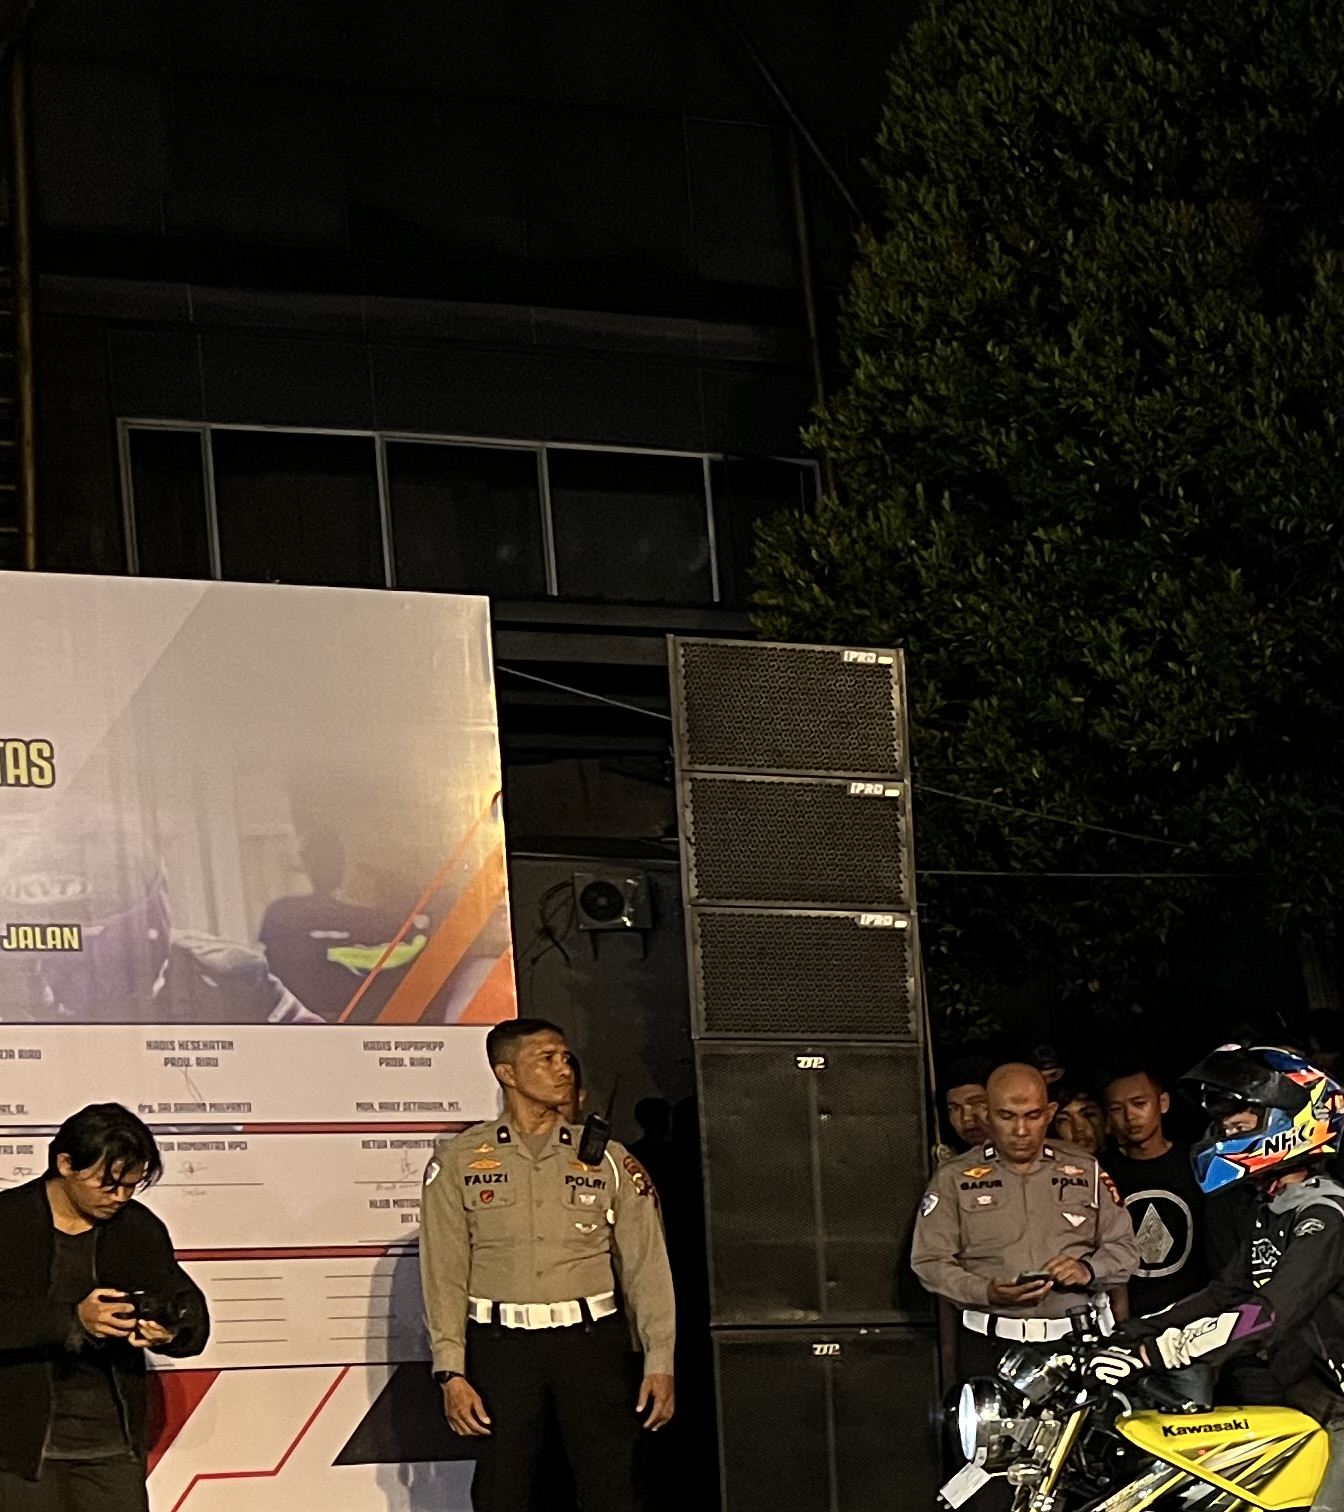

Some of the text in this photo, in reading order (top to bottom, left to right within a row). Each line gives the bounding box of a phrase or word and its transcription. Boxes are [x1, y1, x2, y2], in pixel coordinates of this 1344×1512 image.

[2, 925, 81, 950] JALAN
[464, 1173, 607, 1191] FAUZI POLRI
[1162, 1419, 1250, 1438] Kawasaki
